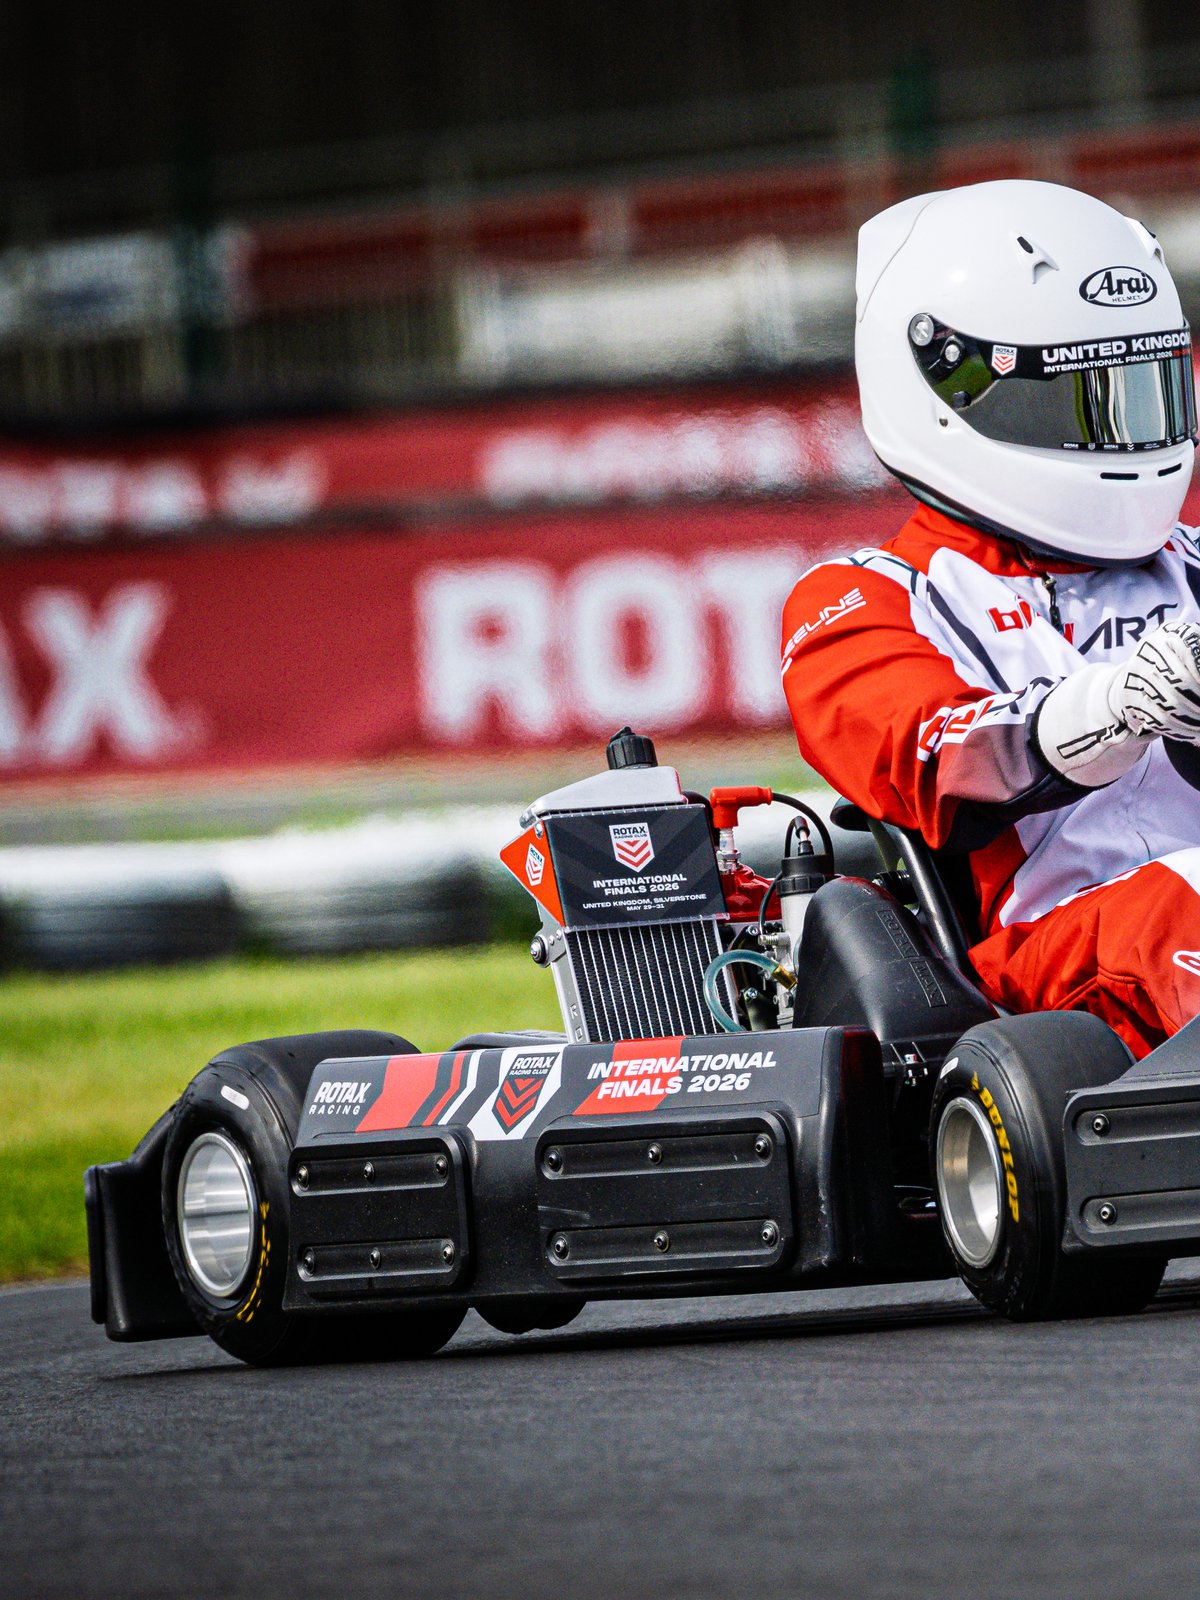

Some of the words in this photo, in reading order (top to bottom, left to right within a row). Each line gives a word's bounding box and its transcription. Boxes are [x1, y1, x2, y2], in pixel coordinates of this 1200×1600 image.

[1088, 270, 1150, 299] Arai
[1042, 340, 1127, 363] UNITED
[1043, 358, 1124, 373] INTERNATIONAL
[1125, 353, 1155, 363] FINALS
[612, 825, 646, 836] ROTAX
[593, 873, 687, 888] INTERNATIONAL
[604, 885, 647, 896] FINALS
[649, 882, 680, 893] 2026
[582, 901, 612, 909] UNITED
[653, 894, 708, 903] SILVERSTONE
[512, 1055, 555, 1071] ROTAX
[587, 1050, 777, 1080] INTERNATIONAL
[509, 1068, 531, 1076] RACING
[531, 1067, 549, 1076] CLUB
[313, 1081, 372, 1105] ROTAX
[597, 1072, 681, 1099] FINALS
[685, 1072, 751, 1094] 2026
[309, 1103, 361, 1116] RACING
